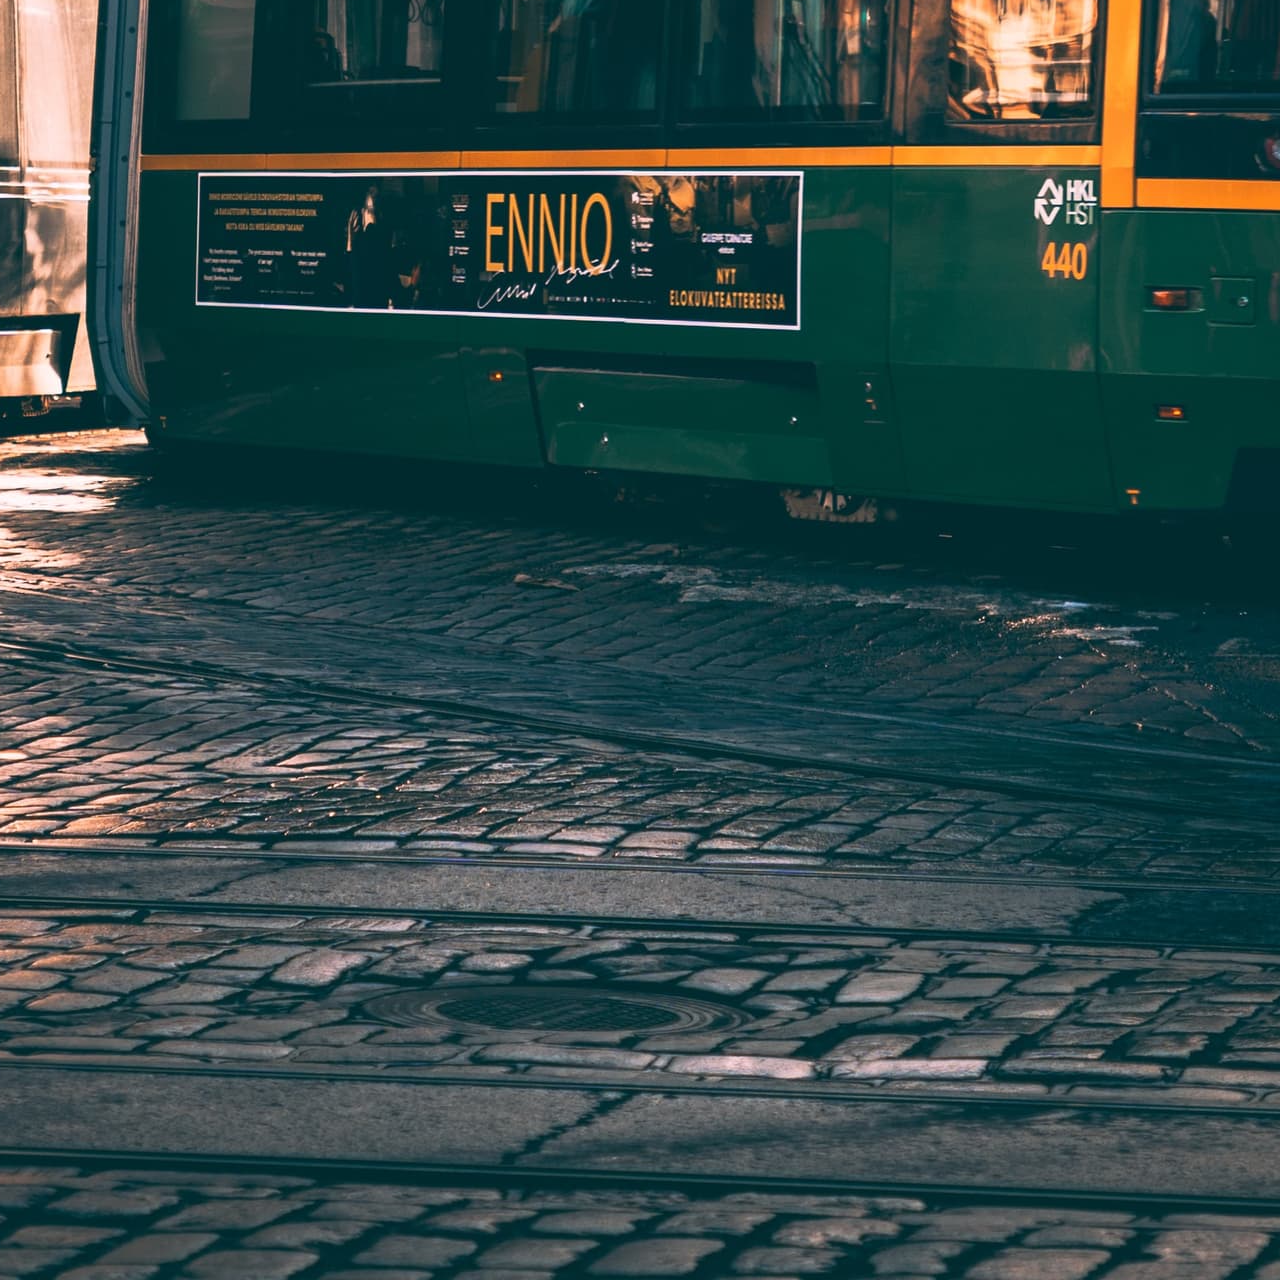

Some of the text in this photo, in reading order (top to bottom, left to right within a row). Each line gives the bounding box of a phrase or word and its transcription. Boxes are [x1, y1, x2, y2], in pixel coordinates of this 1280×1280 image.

[1066, 179, 1097, 201] HKL
[1066, 202, 1097, 225] HST
[485, 191, 613, 276] ENNIO
[1041, 241, 1088, 280] 440
[715, 267, 737, 285] NYT
[669, 289, 787, 311] ELOKUVATEATTEREISSA
